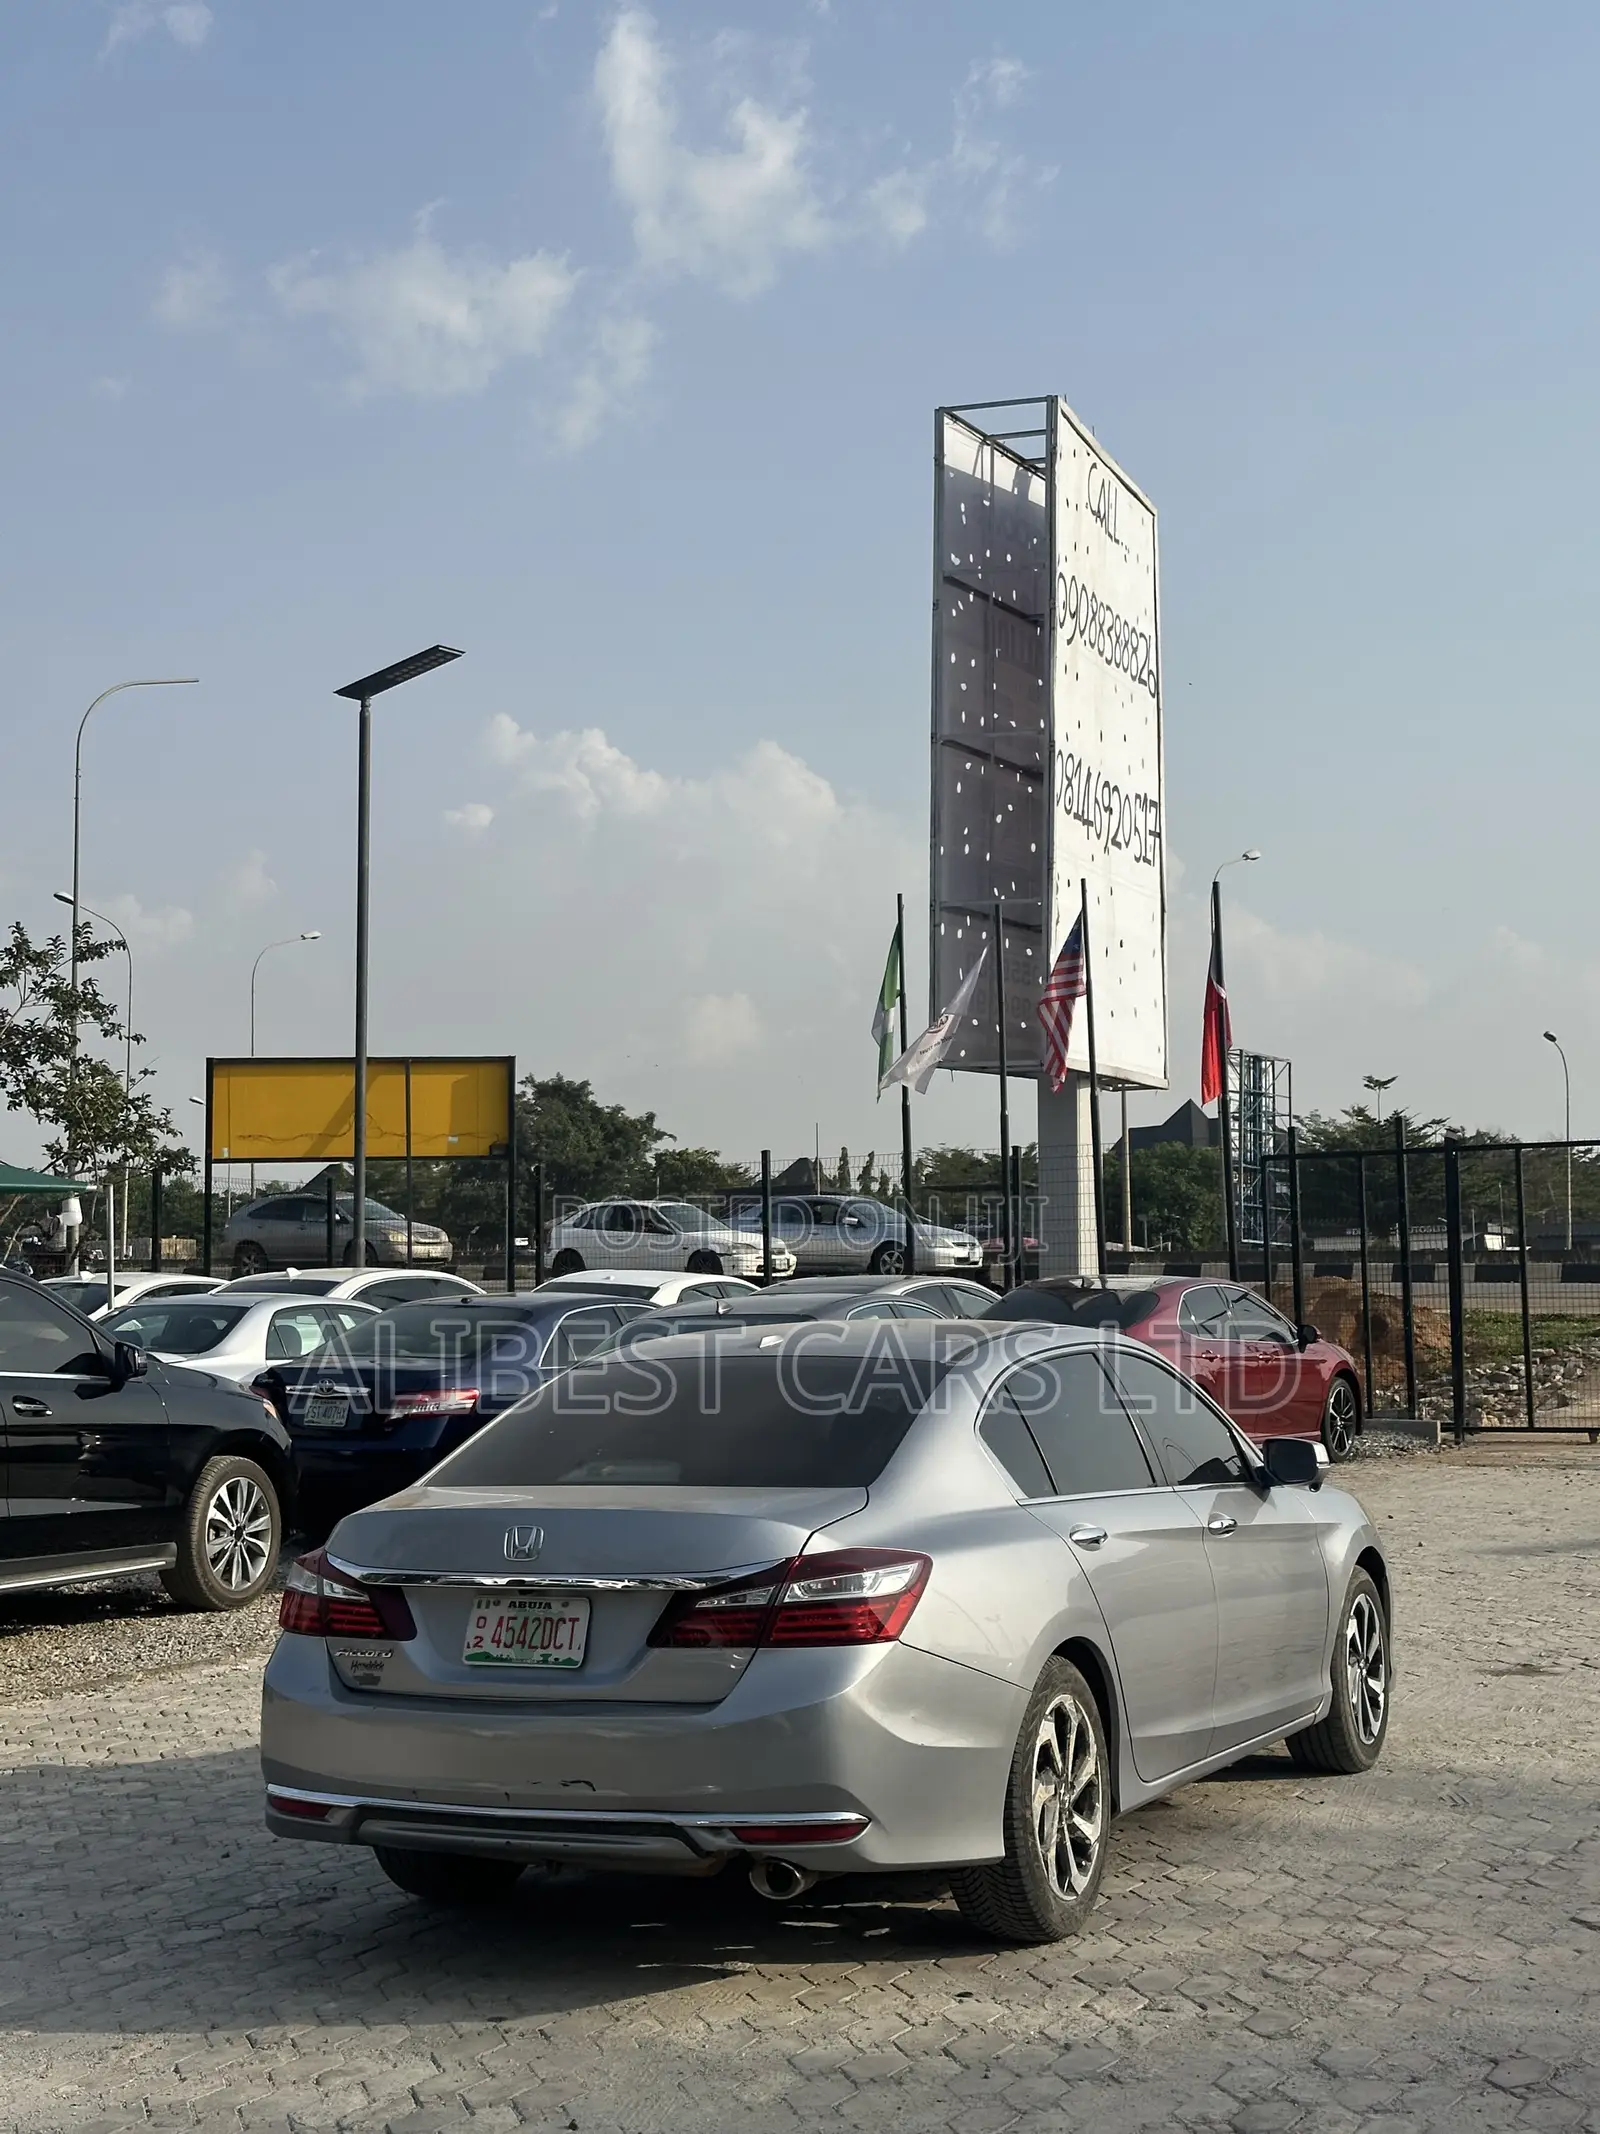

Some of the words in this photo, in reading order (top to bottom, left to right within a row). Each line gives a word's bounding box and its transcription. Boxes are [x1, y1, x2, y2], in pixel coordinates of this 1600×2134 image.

[1057, 572, 1156, 698] 09088388826
[507, 1600, 552, 1609] ABUJA
[491, 1616, 580, 1650] 4542DCT
[334, 1649, 394, 1659] Accord
